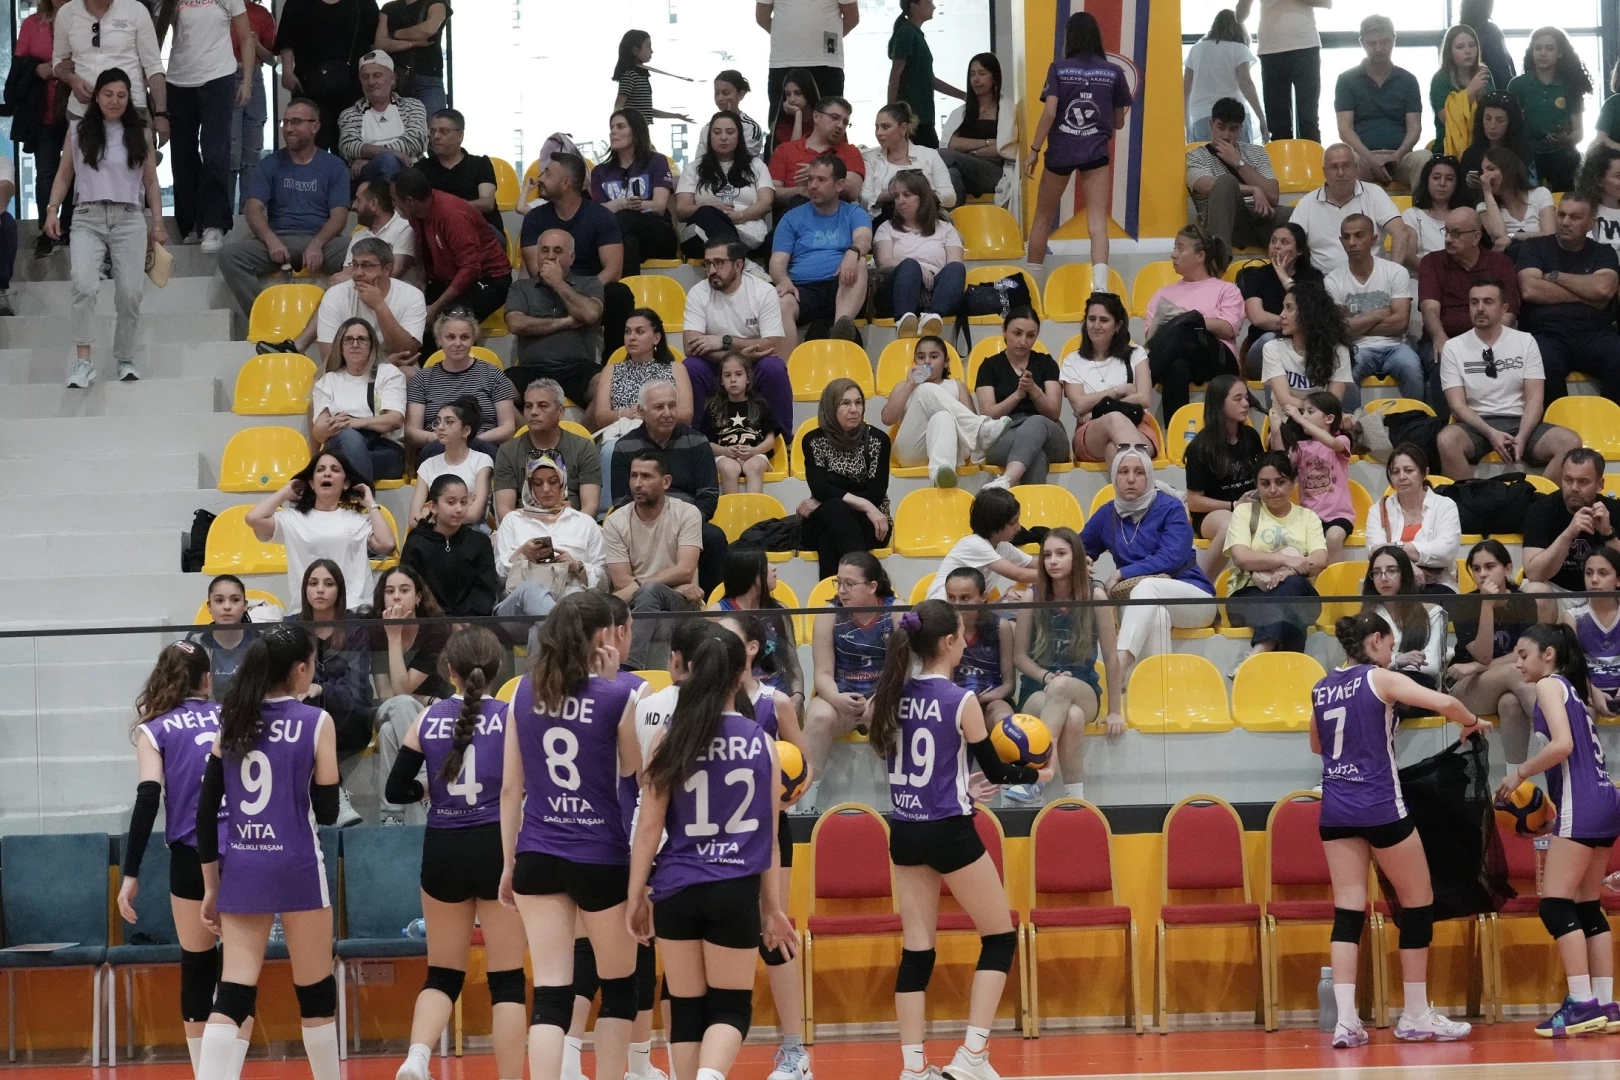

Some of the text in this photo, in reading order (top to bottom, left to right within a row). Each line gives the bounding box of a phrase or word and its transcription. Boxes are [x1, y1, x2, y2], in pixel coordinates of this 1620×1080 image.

[284, 178, 317, 191] mavi
[898, 697, 942, 722] ENA
[268, 719, 302, 743] SU
[424, 713, 503, 739] ZERA
[1323, 706, 1346, 760] 7
[542, 726, 581, 791] 8
[889, 727, 935, 788] 19
[240, 750, 272, 815] 9
[446, 743, 483, 806] 4
[547, 793, 595, 812] VİTA
[684, 768, 759, 836] 12
[236, 820, 276, 839] VİTA
[696, 839, 739, 856] VİTA
